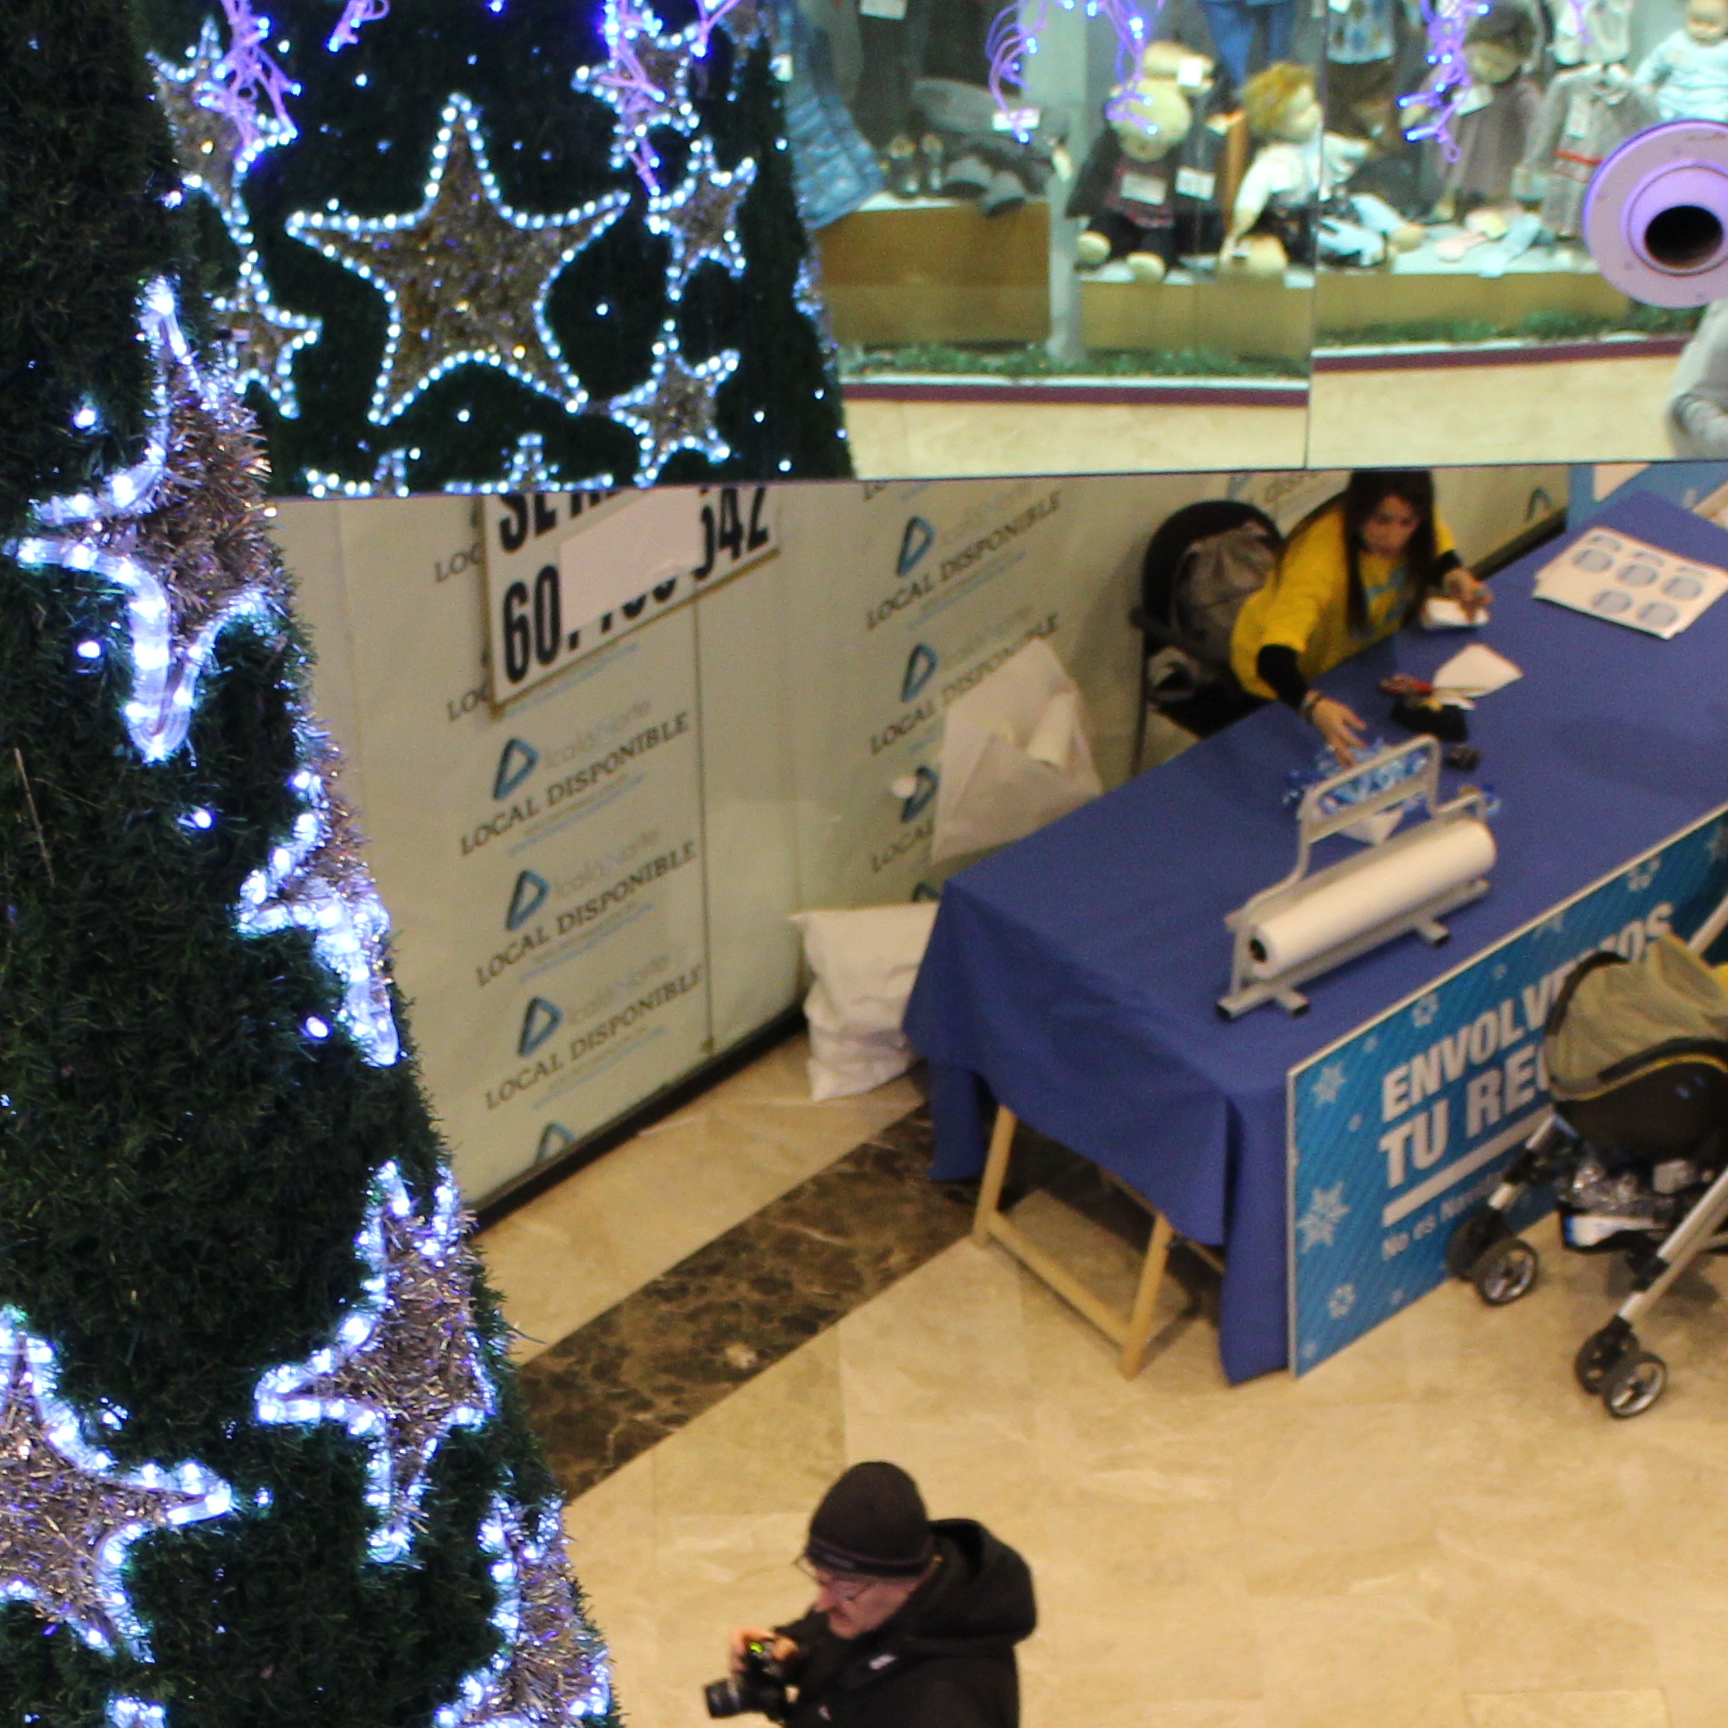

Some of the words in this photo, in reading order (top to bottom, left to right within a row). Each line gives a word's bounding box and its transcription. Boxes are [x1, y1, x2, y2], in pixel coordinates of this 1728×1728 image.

[460, 797, 541, 857] LOCAL
[546, 710, 690, 807] DISPONIBLE
[476, 926, 550, 988] LOCAL
[556, 840, 698, 936] DISPONIBLE
[485, 1052, 565, 1111] LOCAL
[569, 962, 706, 1061] DISPONIBLE
[1378, 1098, 1450, 1190] TU
